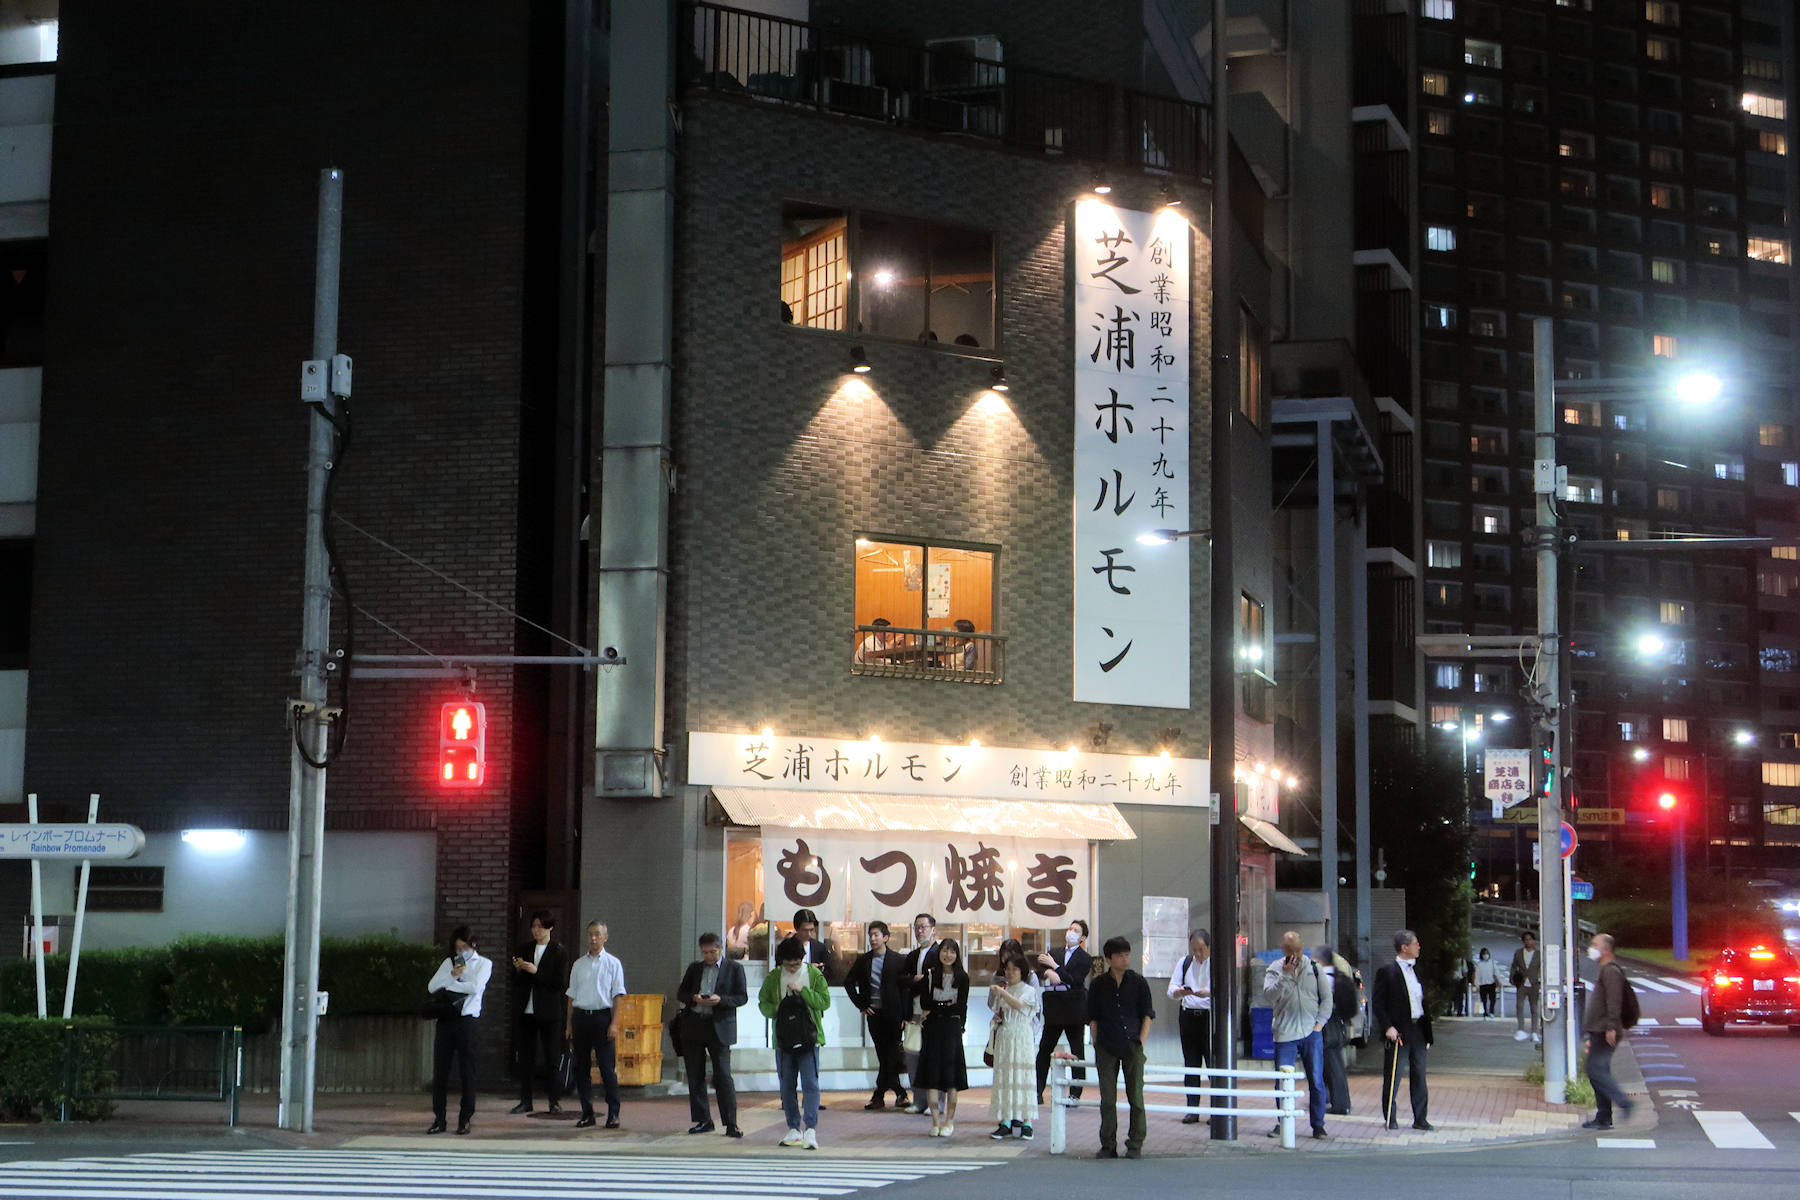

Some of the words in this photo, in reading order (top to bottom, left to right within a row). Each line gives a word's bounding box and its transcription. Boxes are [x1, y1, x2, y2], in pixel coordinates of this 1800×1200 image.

[1149, 236, 1175, 519] 創業昭和二十九年
[1091, 229, 1142, 672] 芝浦ホルモン
[742, 741, 963, 784] 芝浦ホルモン
[1010, 764, 1183, 797] 創業昭和二十九年
[1488, 779, 1525, 790] 商店会
[1495, 766, 1519, 778] 芝浦
[31, 843, 61, 852] Rainbow
[64, 843, 106, 853] Promenade
[777, 838, 1078, 917] もつ焼き
